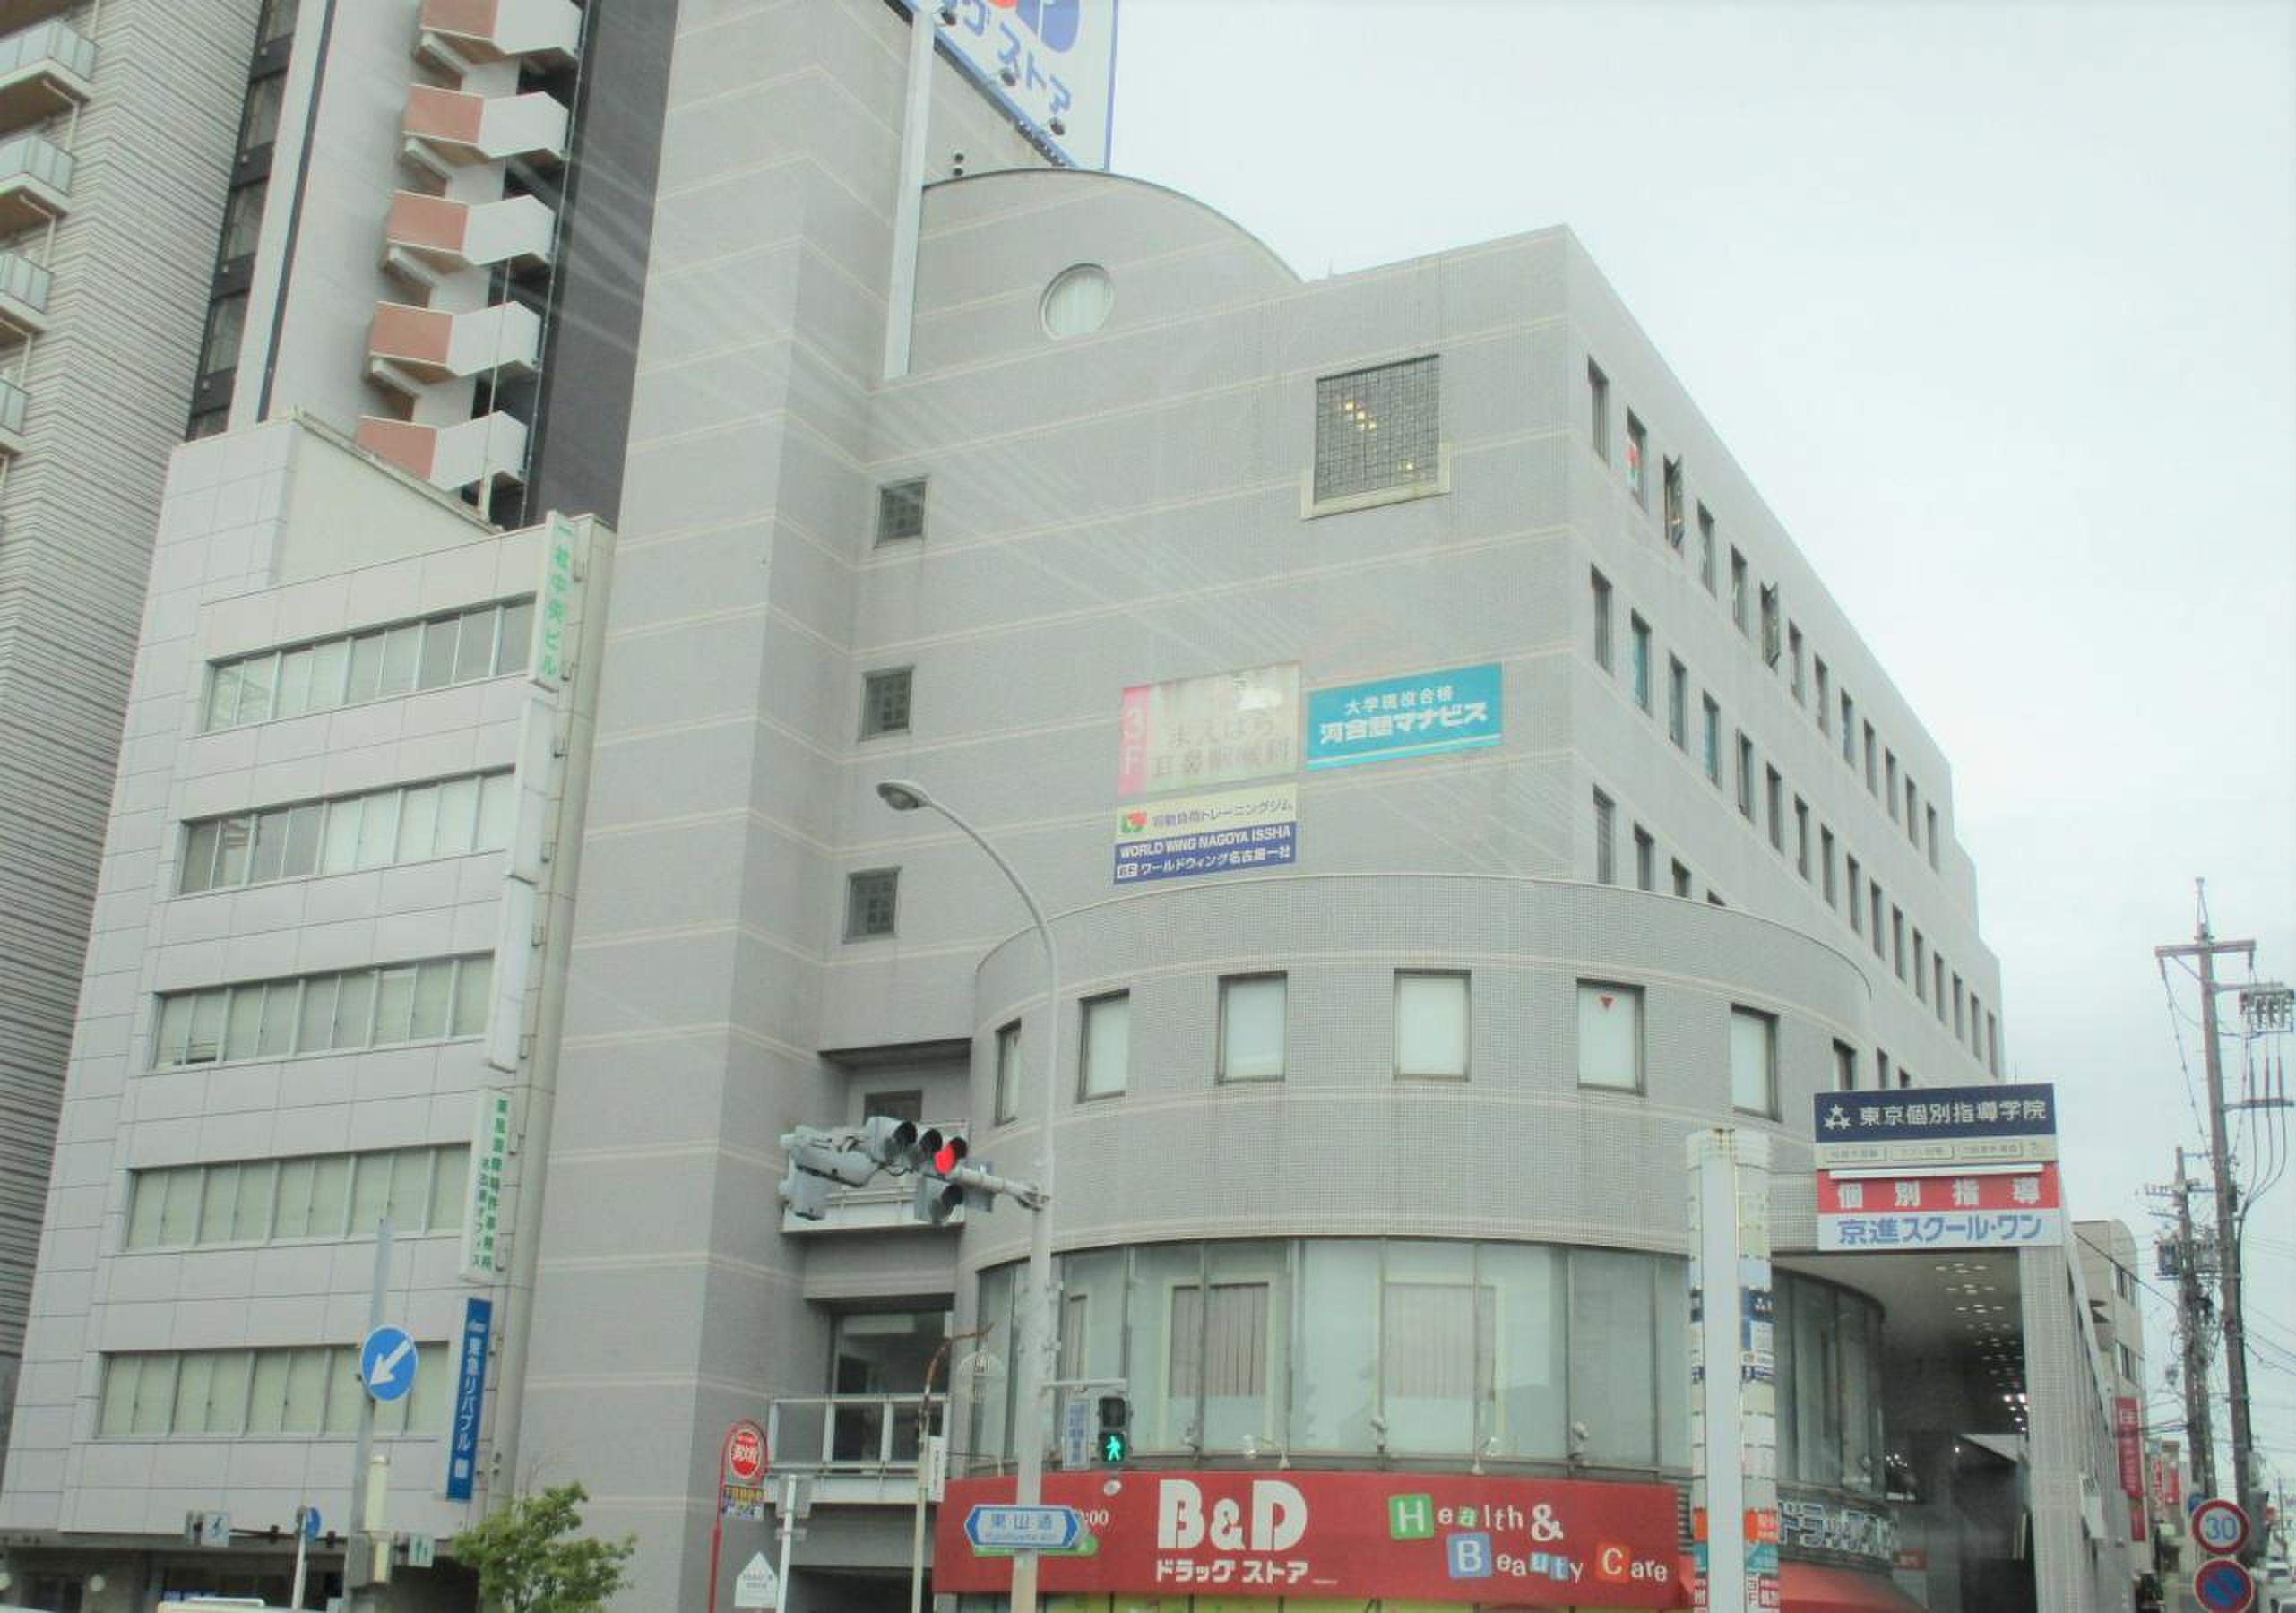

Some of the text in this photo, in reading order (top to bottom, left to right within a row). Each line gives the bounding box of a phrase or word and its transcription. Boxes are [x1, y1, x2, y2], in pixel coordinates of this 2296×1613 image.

[1320, 702, 1488, 745] 河合塾マナビス
[1120, 825, 1291, 858] WORLD WING NAGOYA ISSHA
[1860, 1100, 2047, 1126] 東京個別指導学院
[1158, 1479, 1308, 1551] B&D
[2205, 1515, 2238, 1540] 30
[1457, 1540, 1669, 1584] Beauty Care
